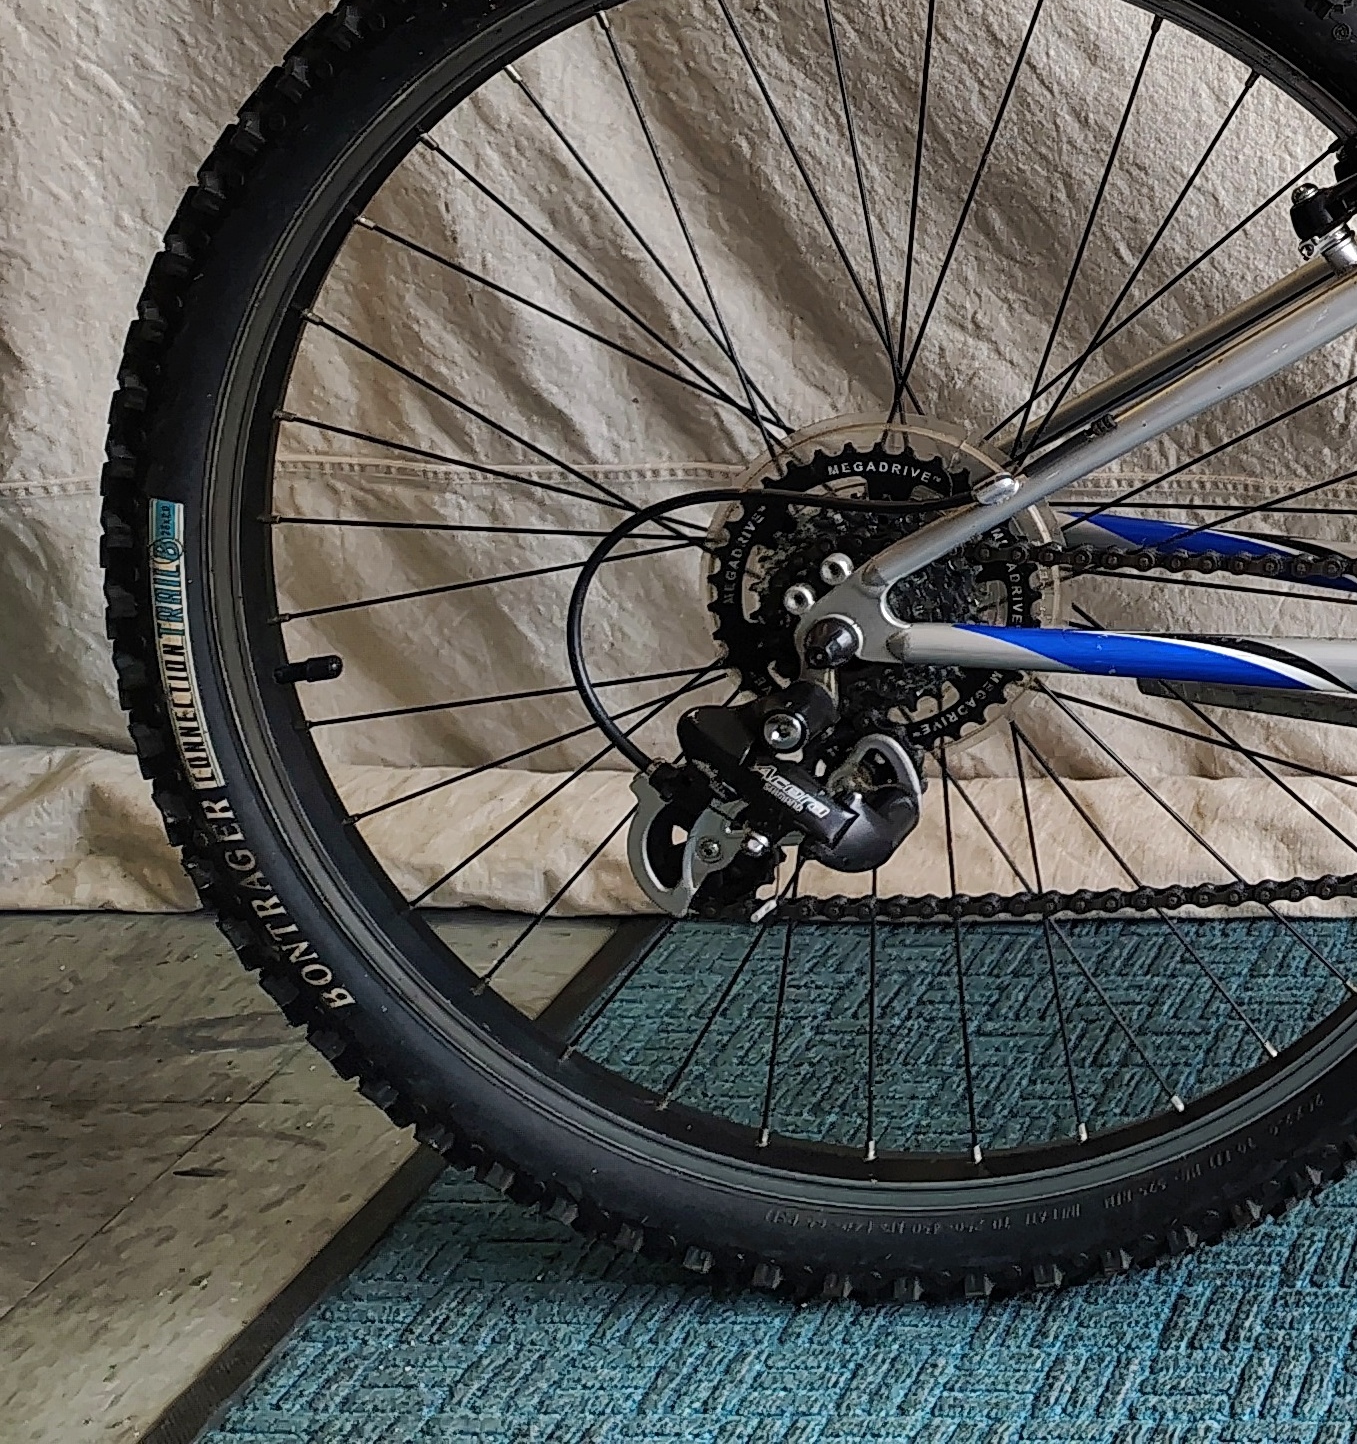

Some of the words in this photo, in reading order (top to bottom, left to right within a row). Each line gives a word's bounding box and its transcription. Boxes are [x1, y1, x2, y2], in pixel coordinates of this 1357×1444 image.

[153, 564, 185, 636] TRAIL
[162, 643, 215, 783] CONNECTION
[748, 762, 831, 819] Acera
[201, 796, 356, 1010] BONTRAGER
